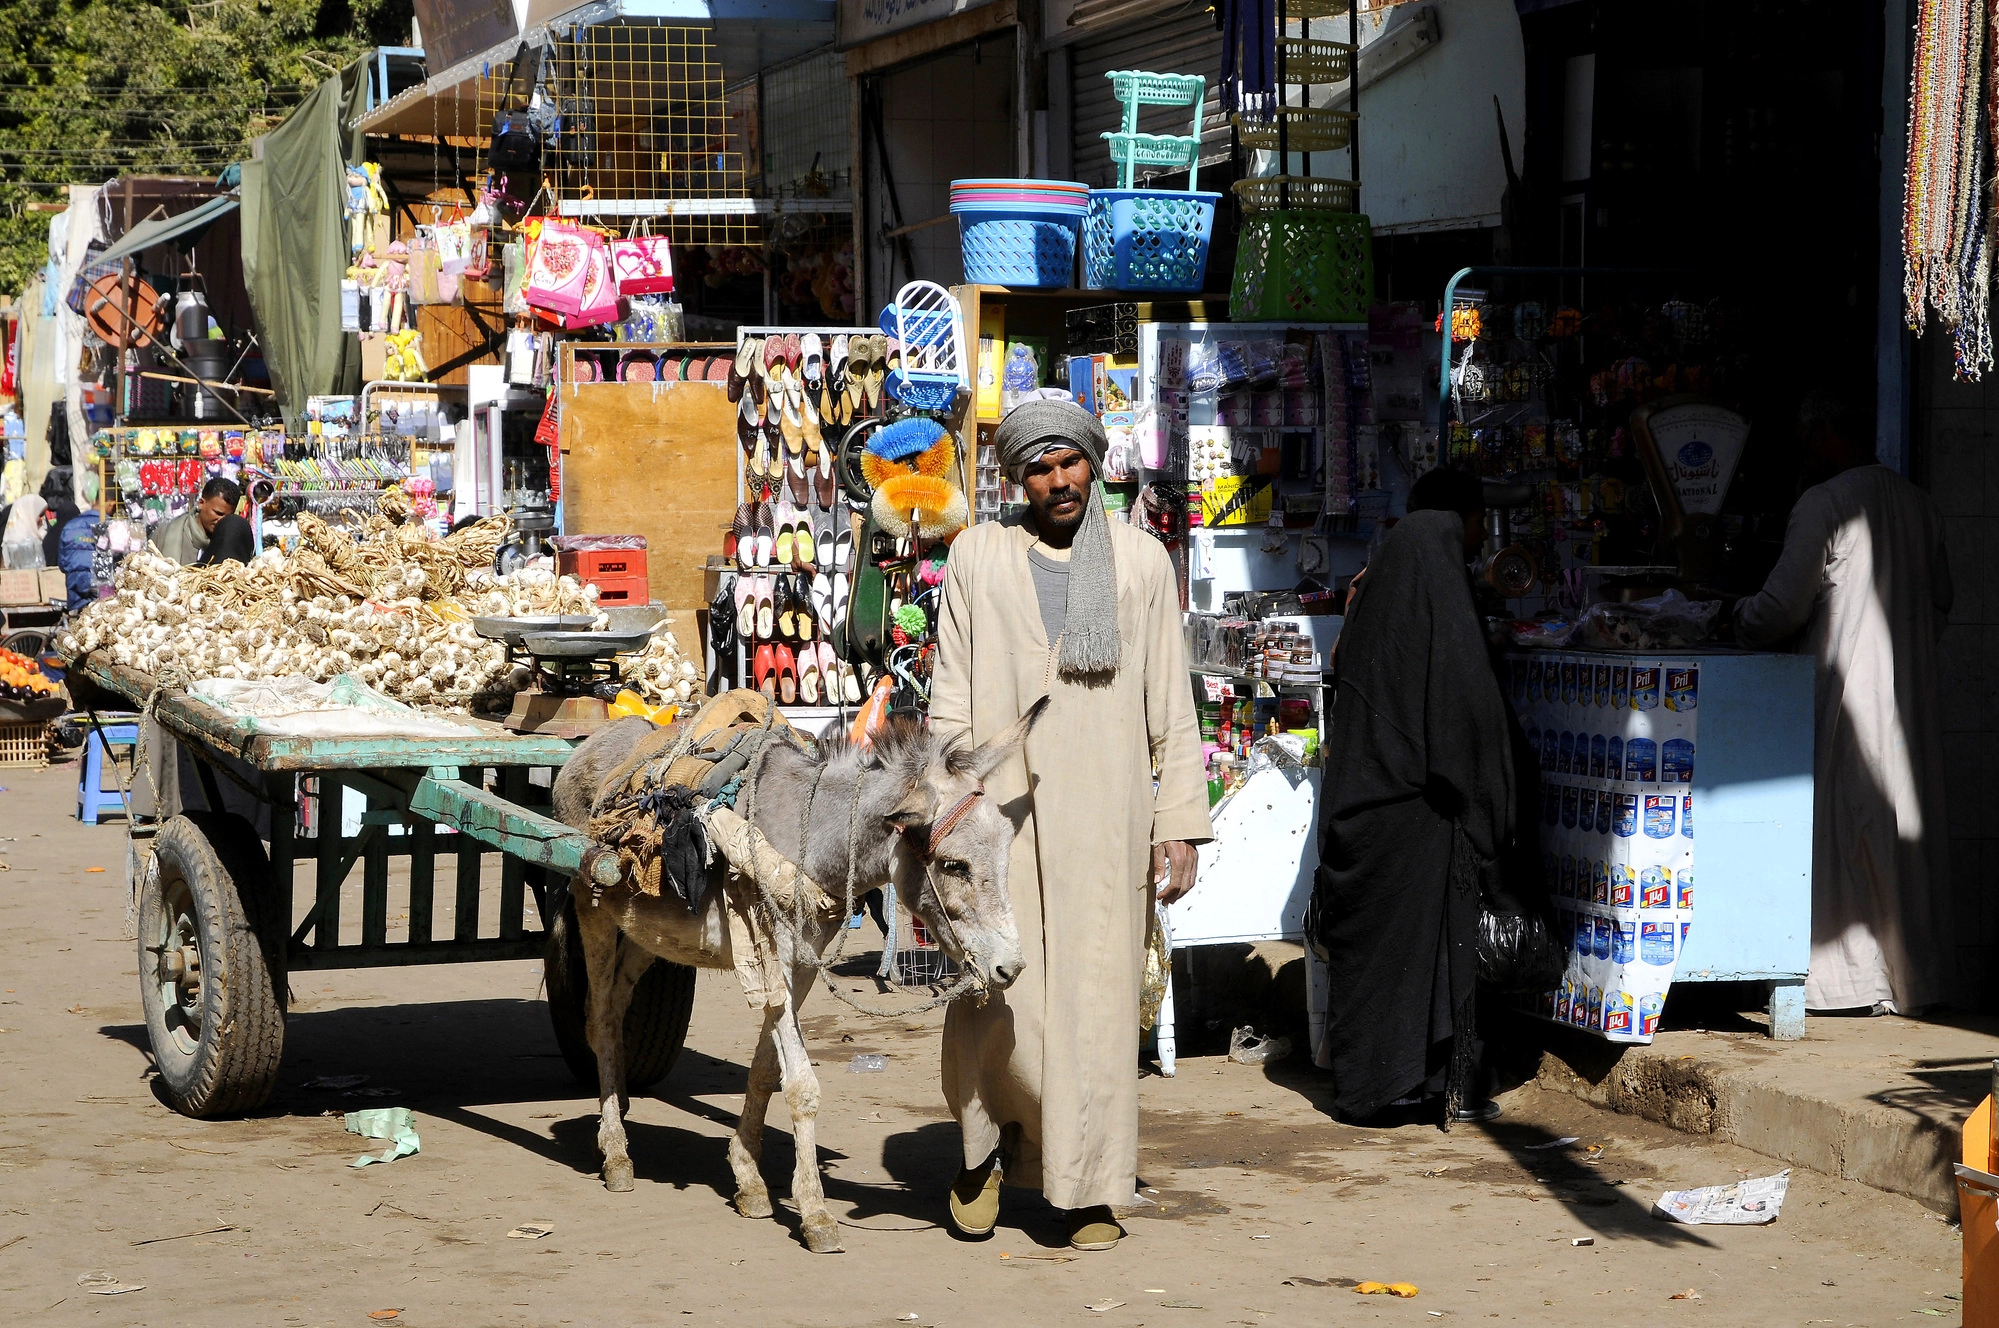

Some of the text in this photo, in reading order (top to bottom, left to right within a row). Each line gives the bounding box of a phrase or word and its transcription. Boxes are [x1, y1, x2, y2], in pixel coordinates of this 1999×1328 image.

[1205, 680, 1219, 689] Best
[1635, 672, 1651, 688] Pril
[1673, 673, 1689, 689] Pril
[1614, 887, 1627, 903] Pril
[1649, 888, 1663, 905] Pril
[1608, 1013, 1625, 1029] Pril
[1649, 1017, 1660, 1032] ril
